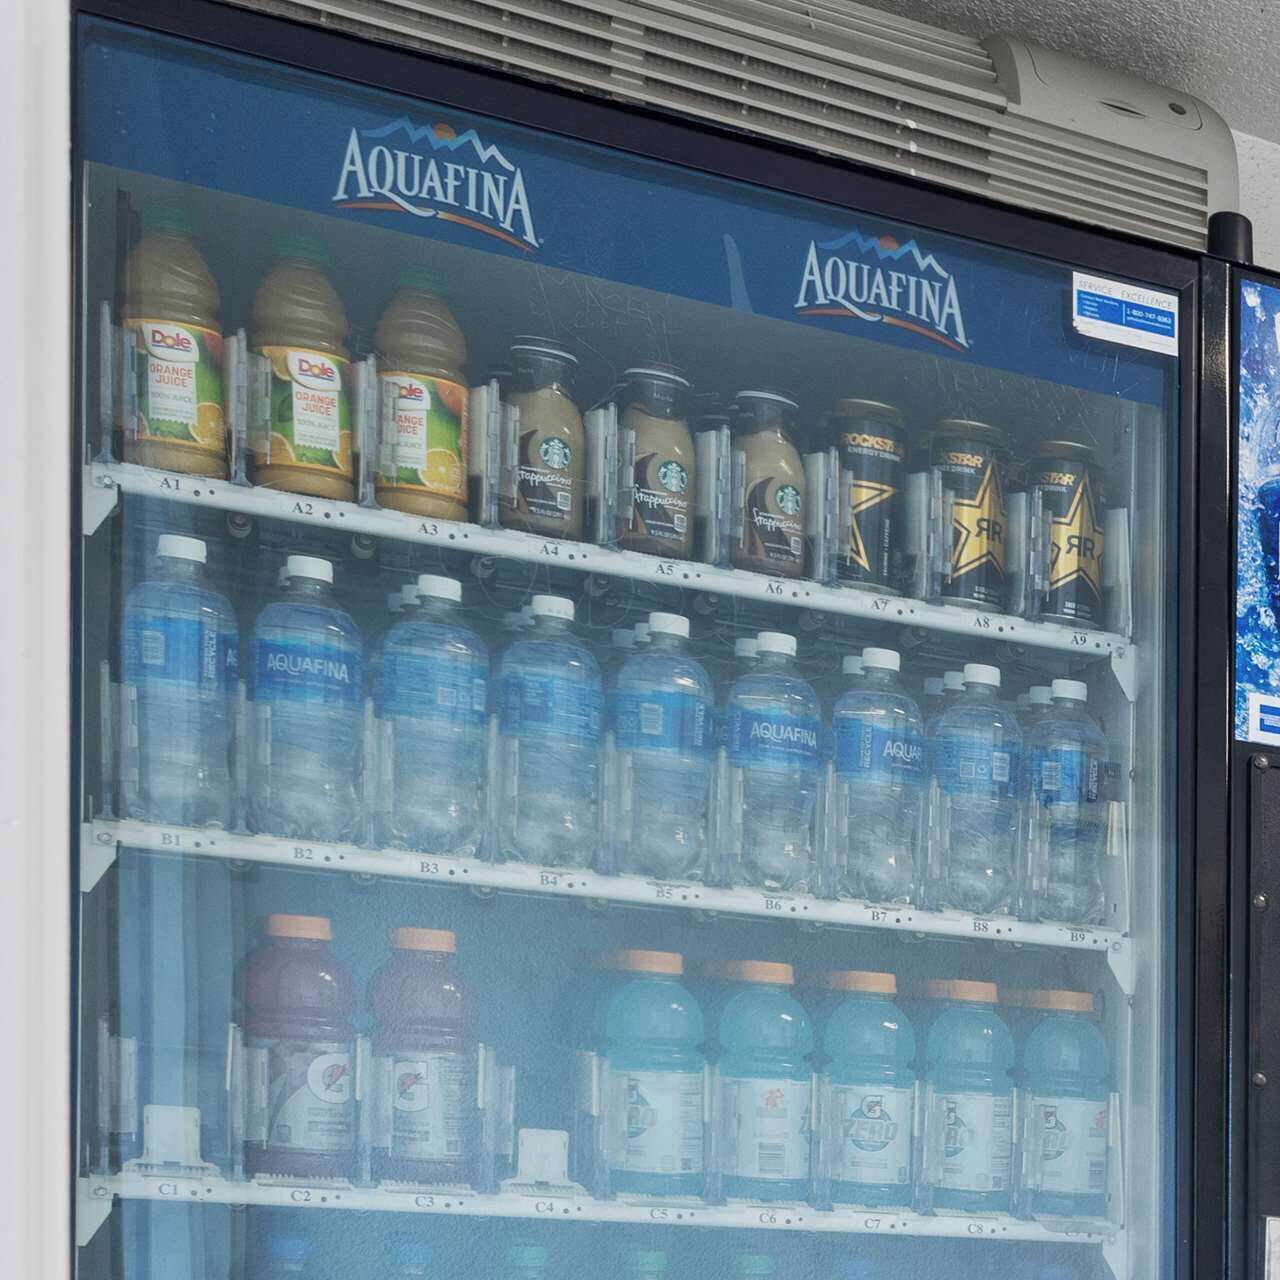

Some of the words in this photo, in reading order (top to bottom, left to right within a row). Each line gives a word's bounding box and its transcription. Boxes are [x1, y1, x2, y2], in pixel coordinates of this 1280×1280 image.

[333, 128, 541, 249] AQUAFINA
[794, 241, 971, 348] AQUAFINA
[151, 328, 192, 350] Dole
[149, 362, 193, 380] ORANGE
[299, 357, 335, 379] Dole
[154, 373, 188, 388] JUICE
[295, 391, 337, 407] ORANGE
[302, 401, 332, 417] JUICE
[159, 477, 181, 490] A1
[292, 503, 314, 516] A2
[418, 523, 439, 536] A3
[539, 544, 559, 556] A4
[656, 564, 674, 576] A5
[765, 582, 783, 595] A6
[871, 600, 888, 611] A7
[974, 617, 990, 629] A8
[1071, 634, 1087, 646] A9
[266, 653, 351, 685] AQUAFINA
[750, 721, 818, 748] AQUAFINA
[161, 833, 181, 846] B1
[293, 847, 313, 860] B2
[420, 861, 439, 873] B3
[540, 874, 557, 887] B4
[656, 887, 673, 899] B5
[765, 899, 782, 911] B6
[871, 911, 887, 922] B7
[973, 922, 989, 933] B8
[1070, 931, 1086, 943] B9
[158, 1183, 179, 1197] C1
[291, 1190, 312, 1203] C2
[415, 1196, 435, 1208] C3
[535, 1201, 554, 1214] C4
[650, 1209, 669, 1221] C5
[759, 1212, 777, 1225] C6
[864, 1219, 881, 1230] C7
[967, 1223, 984, 1234] C8
